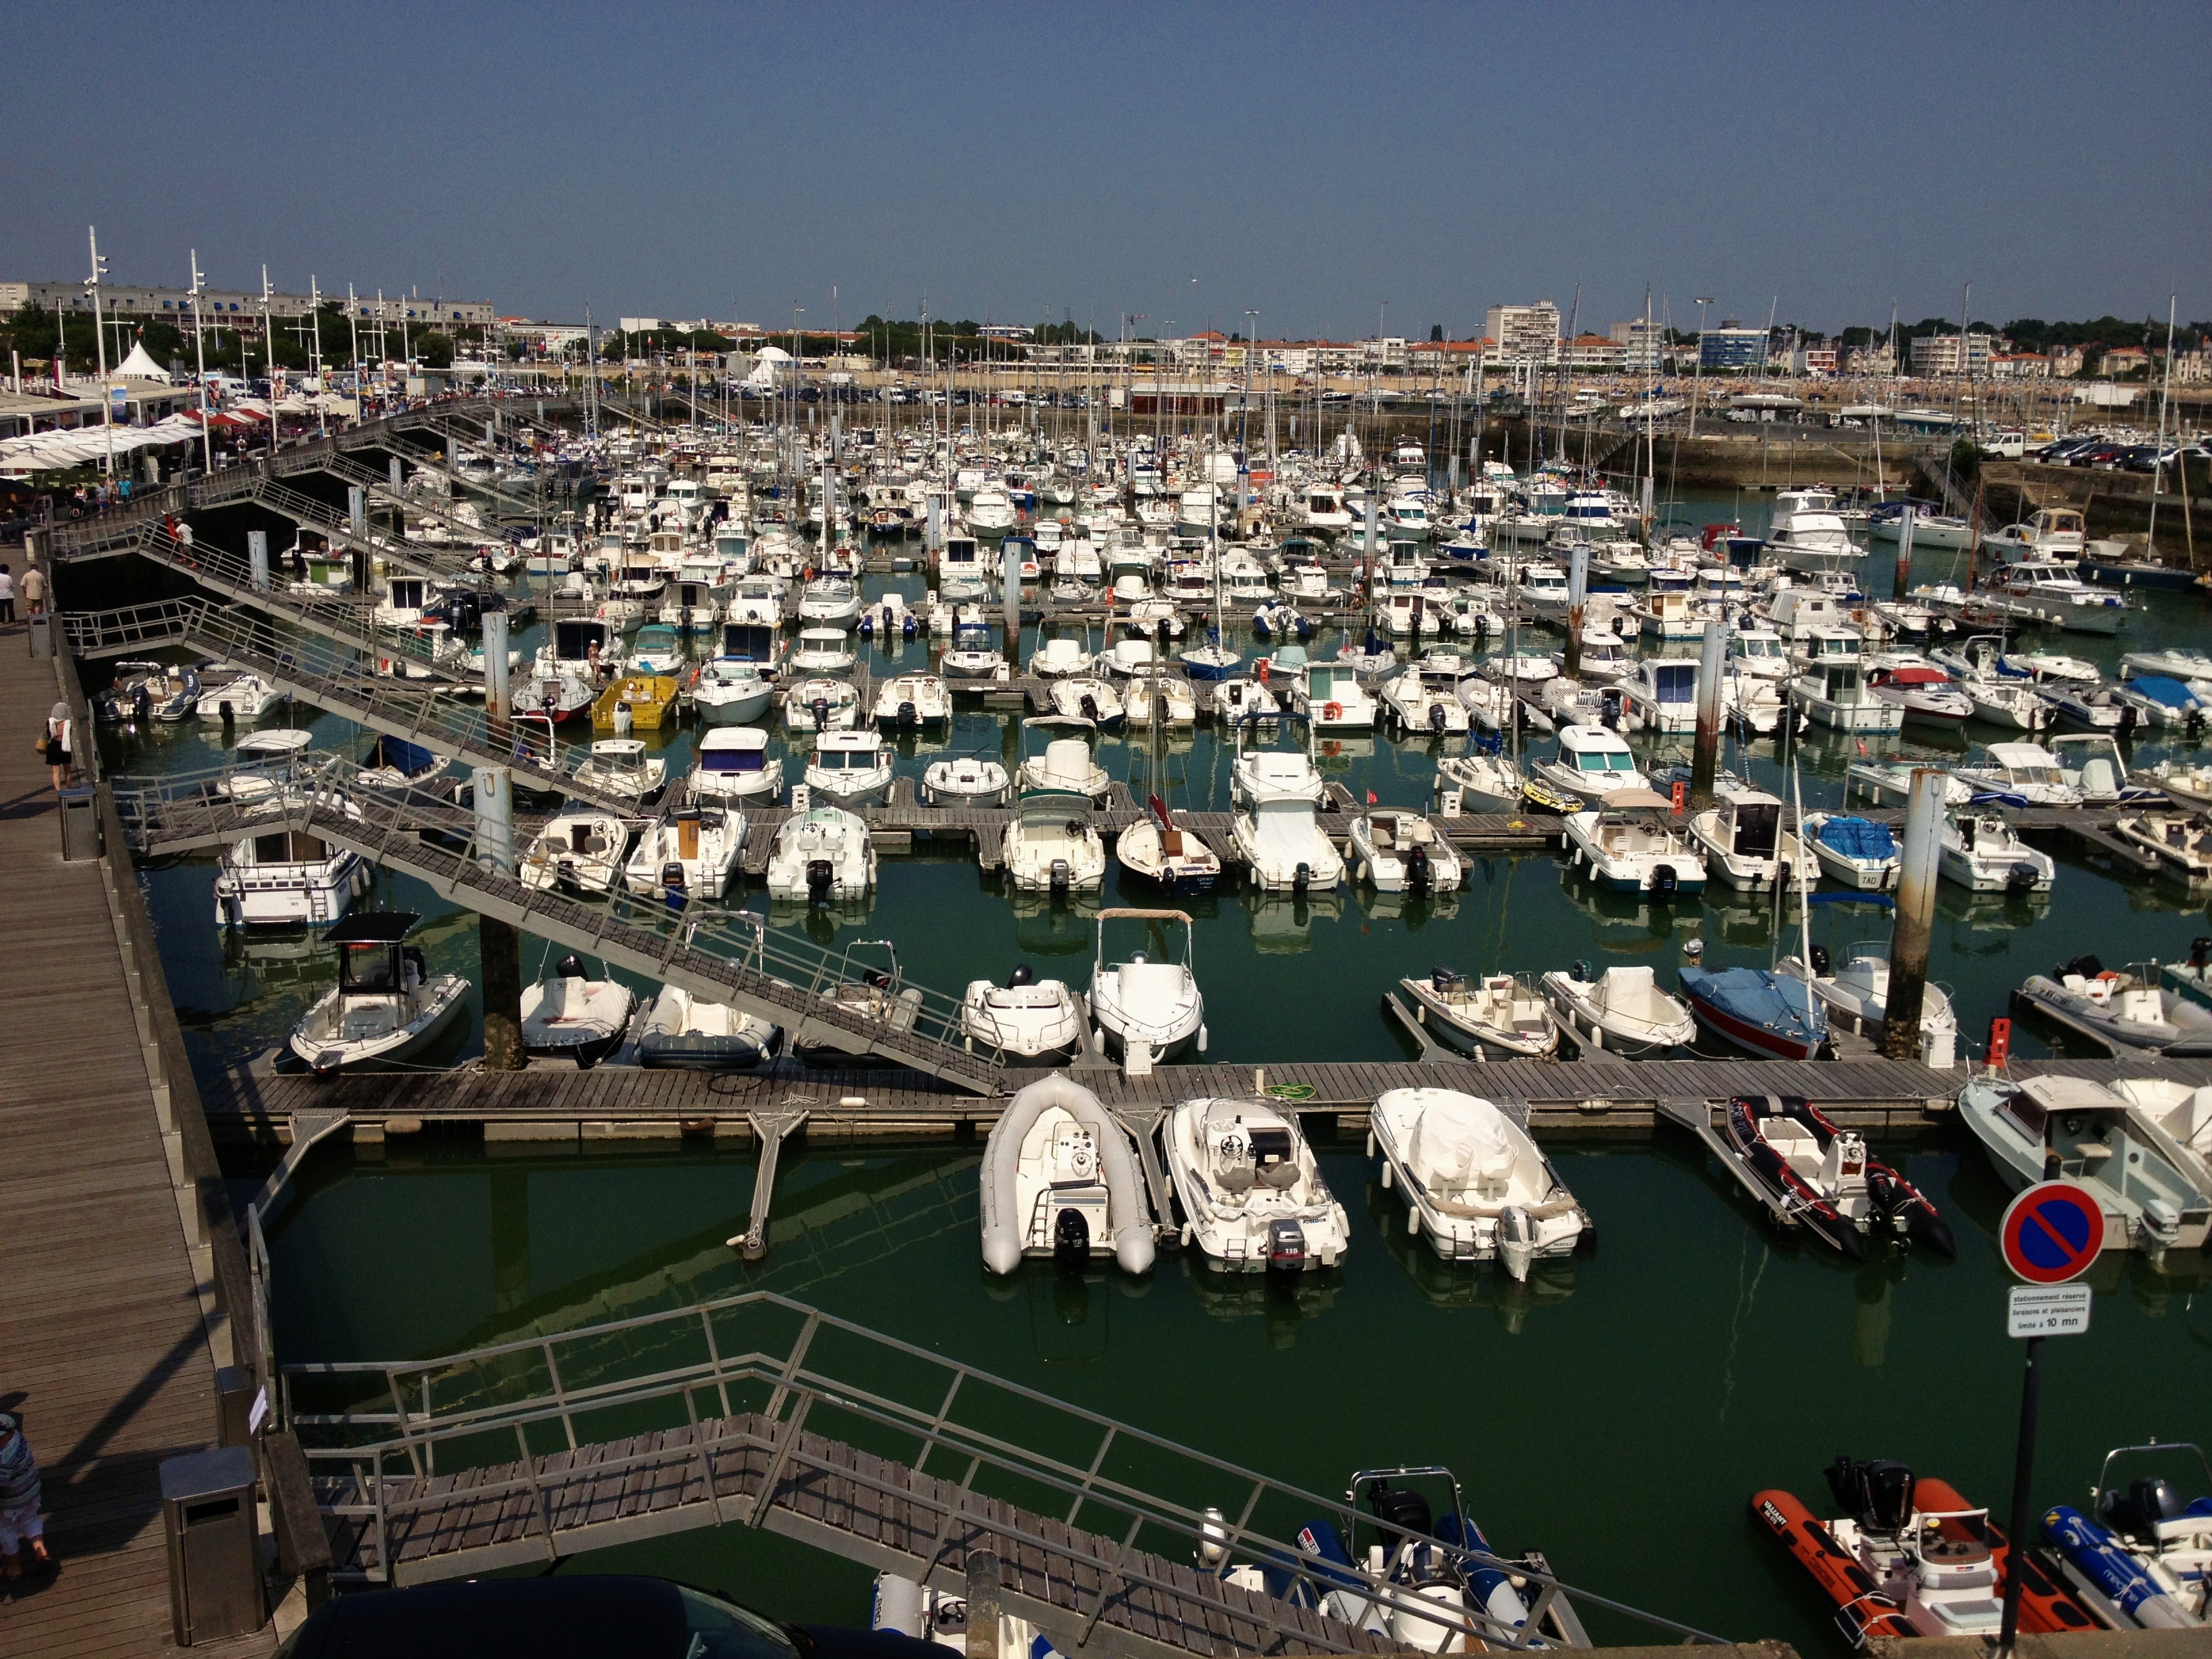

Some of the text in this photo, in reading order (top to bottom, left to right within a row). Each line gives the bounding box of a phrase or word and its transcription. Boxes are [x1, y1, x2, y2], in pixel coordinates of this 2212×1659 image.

[2013, 1294, 2060, 1303] stationnement
[2051, 1306, 2085, 1314] plaisanciers
[2047, 1317, 2057, 1328] 10
[2062, 1318, 2078, 1326] mn
[1764, 1500, 1788, 1525] VALIANT
[874, 1598, 883, 1625] PRO
